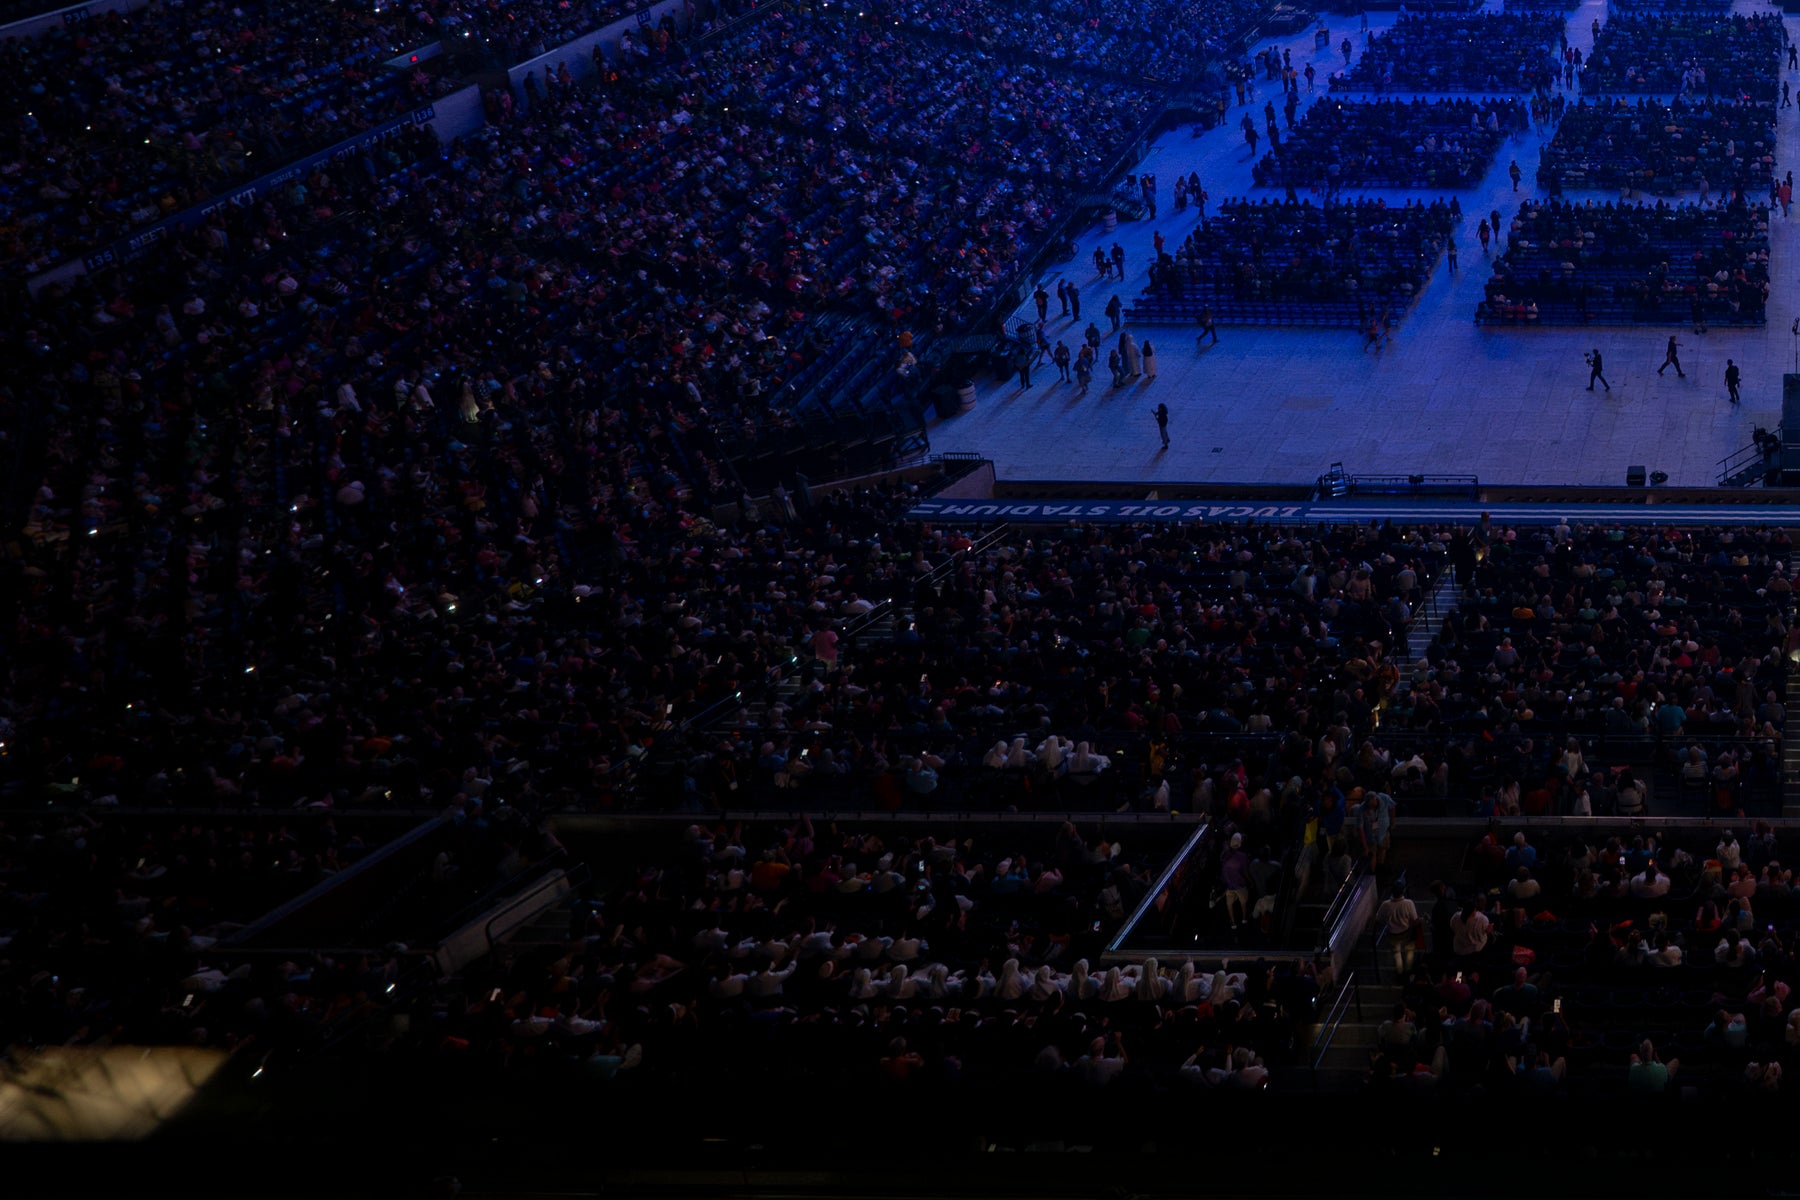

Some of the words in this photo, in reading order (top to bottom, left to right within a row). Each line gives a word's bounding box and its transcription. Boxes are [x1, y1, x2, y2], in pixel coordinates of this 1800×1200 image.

[416, 108, 433, 122] 136
[87, 250, 112, 269] 135
[939, 504, 1111, 516] STADIUM
[1117, 505, 1180, 517] OIL
[1182, 505, 1302, 517] LUCAS
